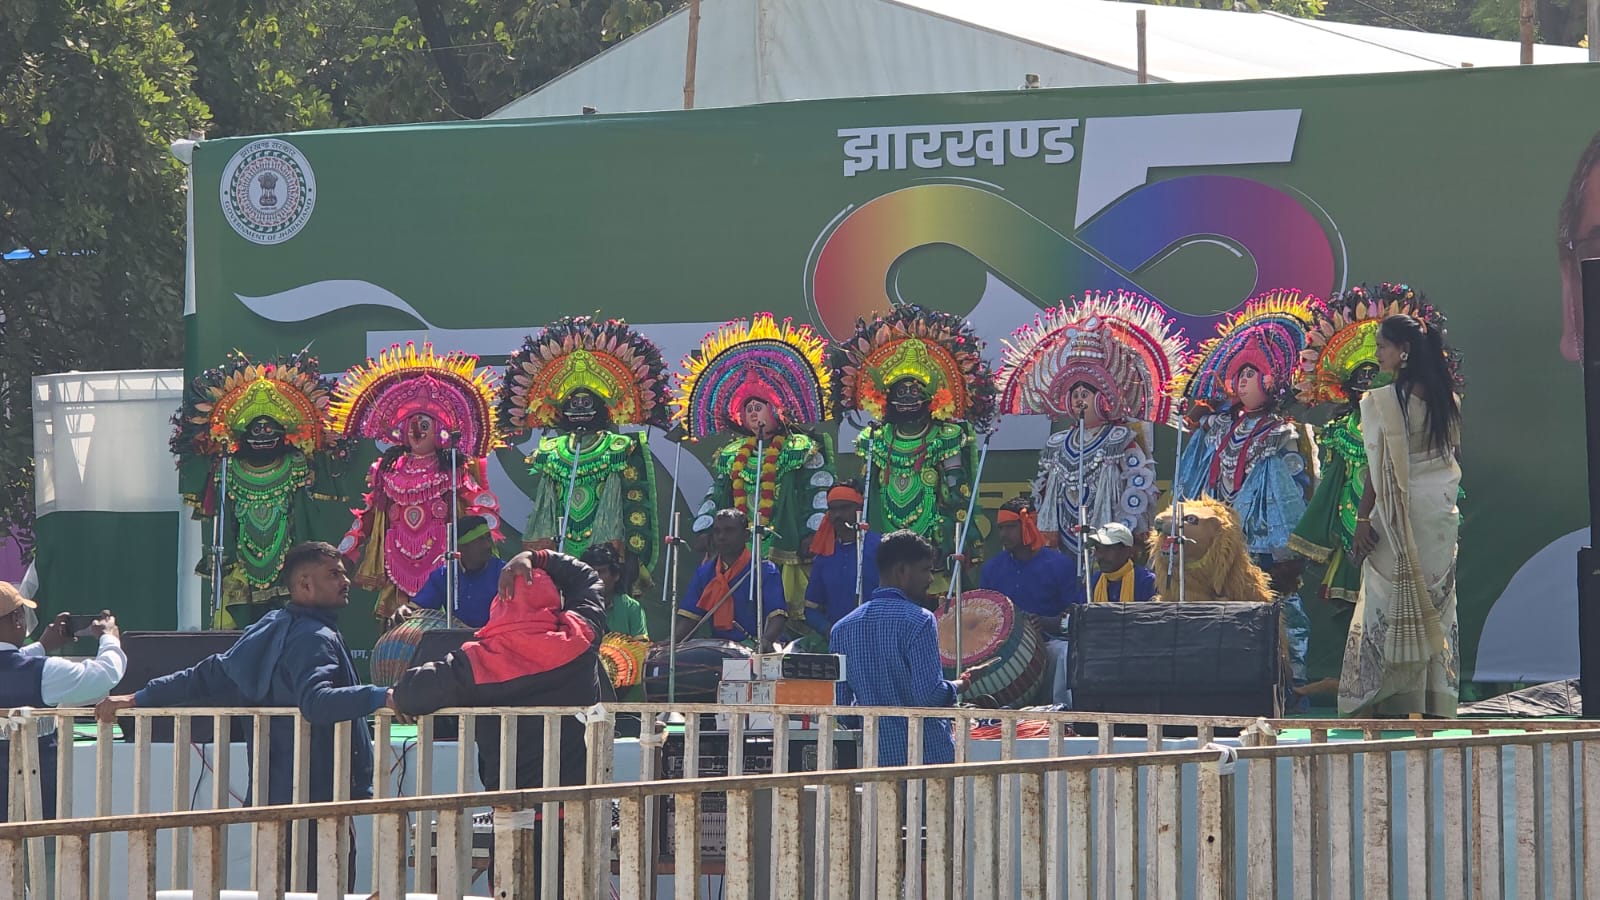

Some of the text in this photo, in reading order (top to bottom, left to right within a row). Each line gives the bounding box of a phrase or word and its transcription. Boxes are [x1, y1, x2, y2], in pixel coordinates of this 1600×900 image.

[272, 142, 296, 156] सरकार
[837, 118, 1080, 176] झारखण्ड
[225, 201, 266, 241] GOVERNMENT
[278, 198, 313, 239] JHARKHAND
